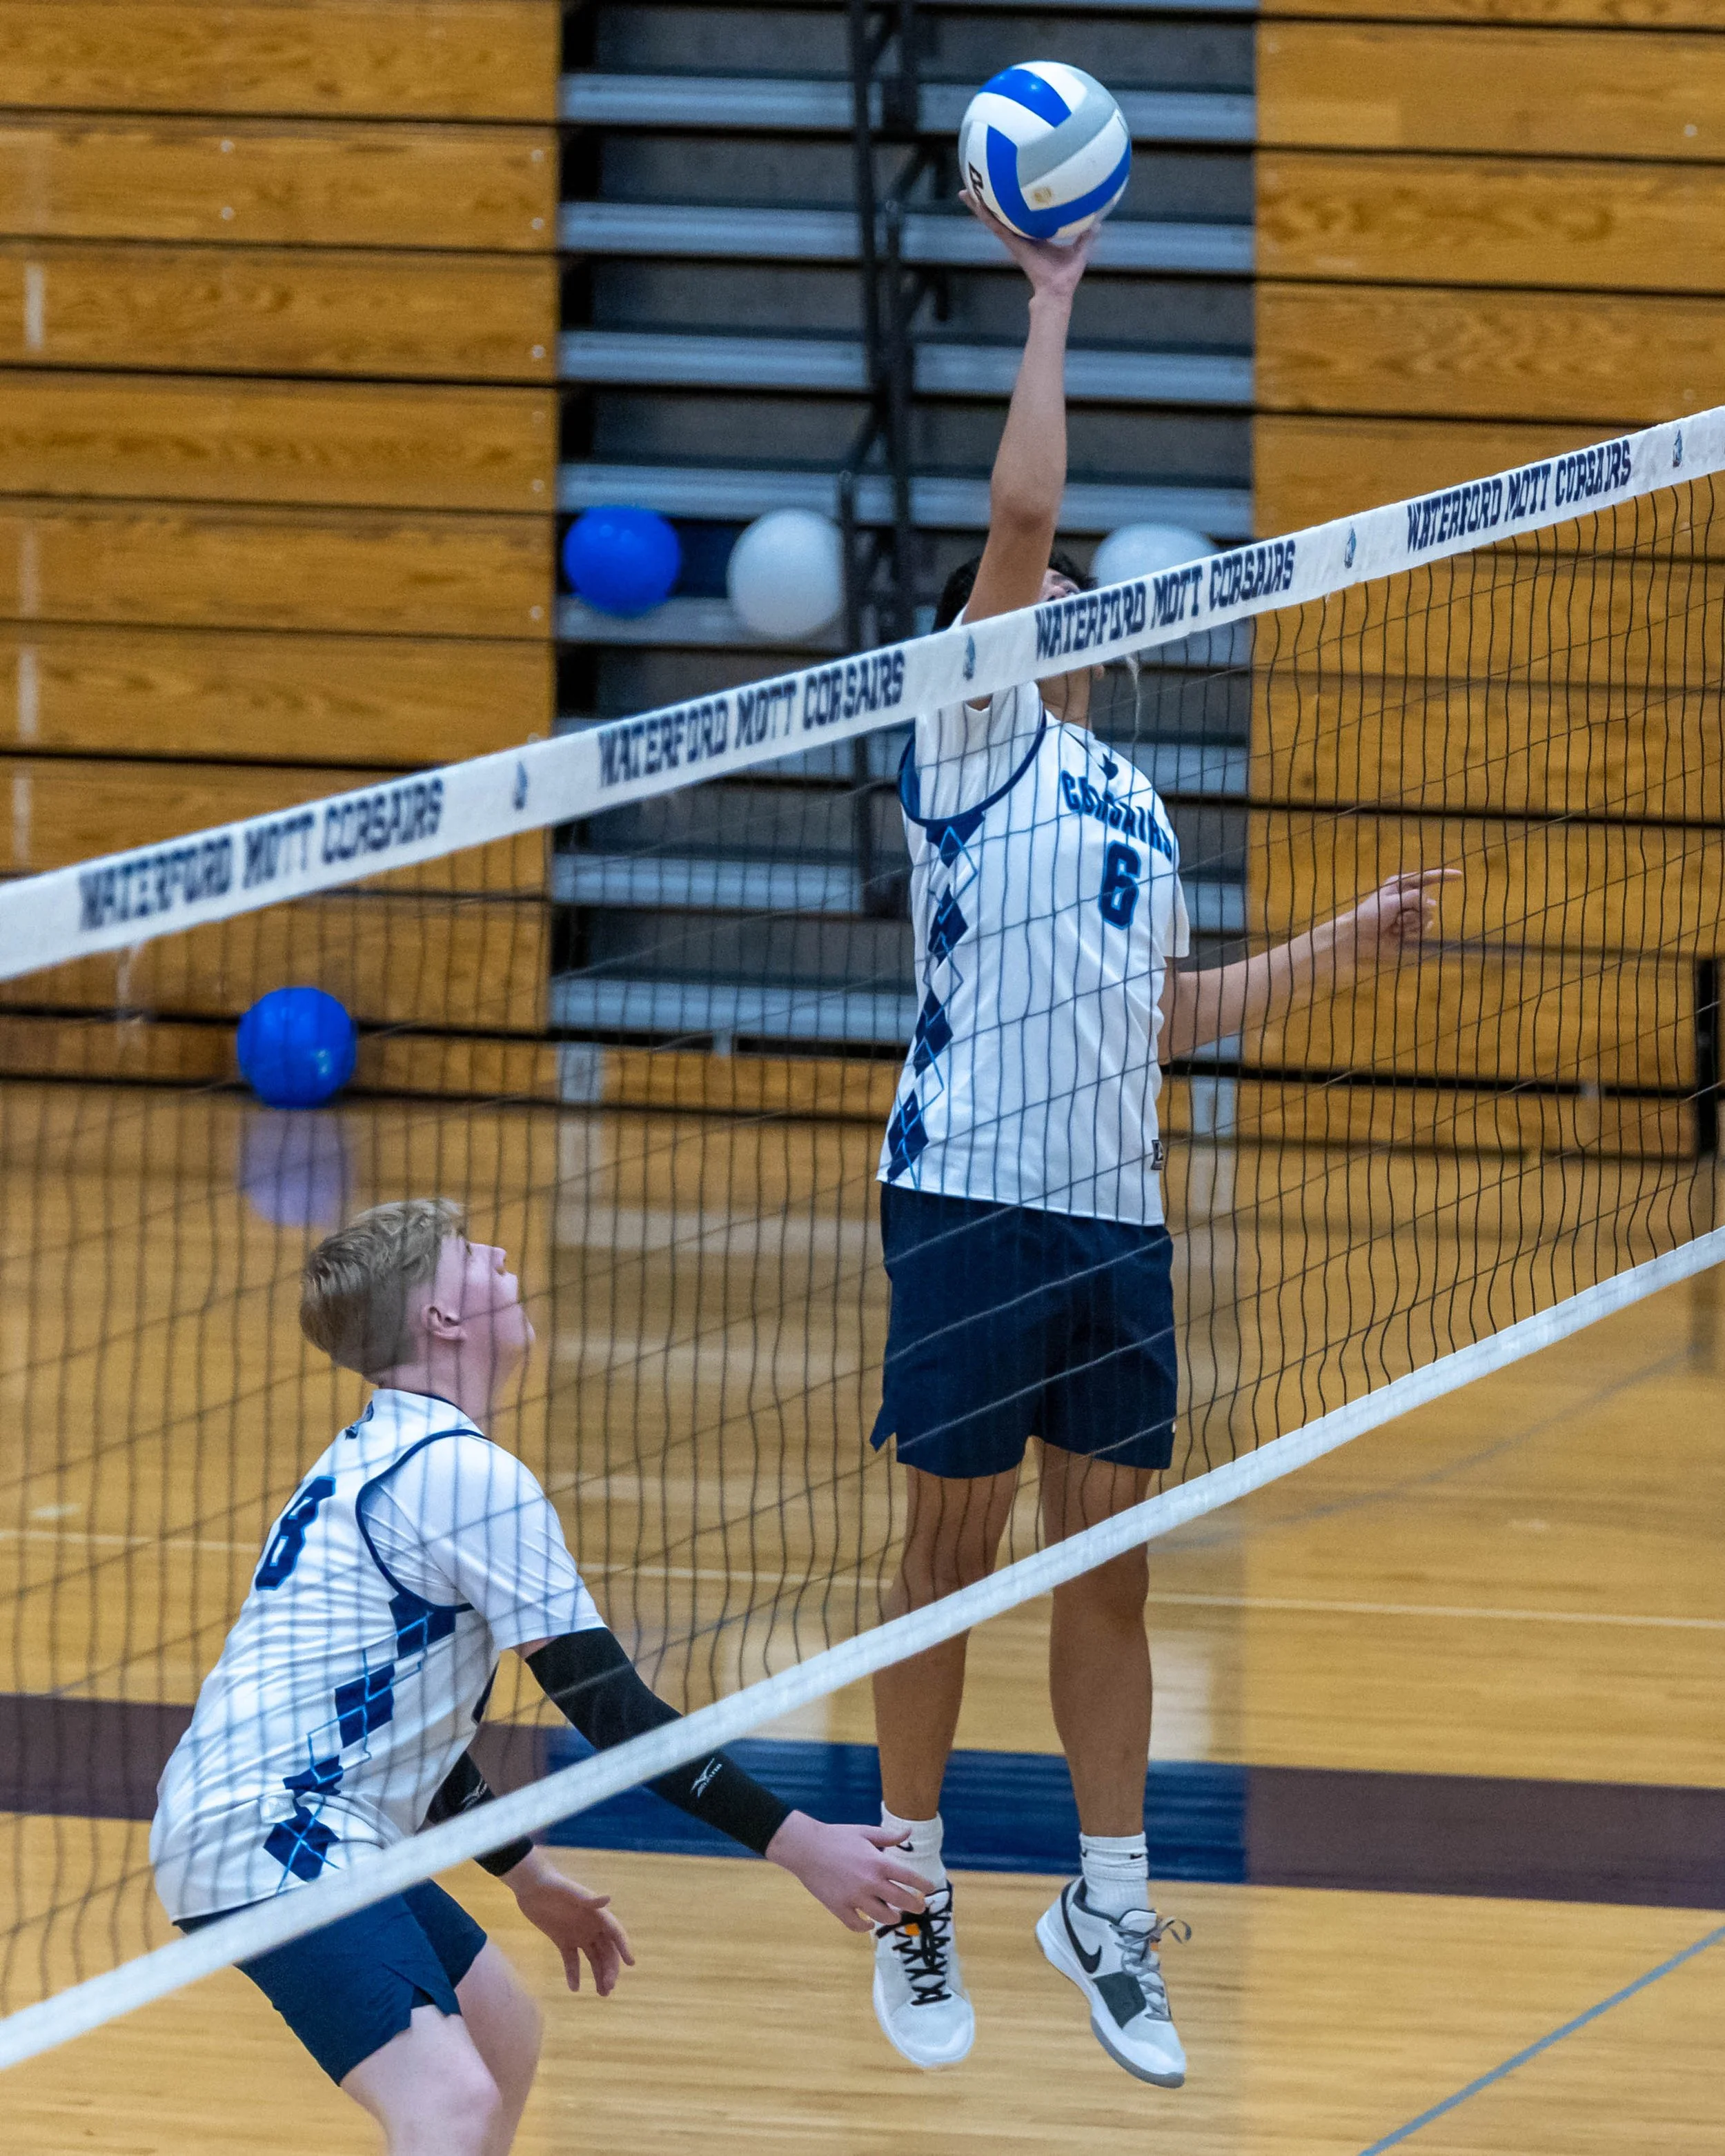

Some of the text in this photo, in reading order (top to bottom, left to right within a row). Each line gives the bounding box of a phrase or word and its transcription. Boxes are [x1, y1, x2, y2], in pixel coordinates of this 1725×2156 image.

[1407, 439, 1631, 553] WATERFORD MOTT CORSAIRS
[1036, 539, 1296, 660] WATERFORD MOTT CORSAIRS
[598, 649, 905, 788] WATERFORD MOTT CORSAIRS
[78, 778, 443, 931] WATERFORD MOTT CORSAIRS
[1098, 840, 1141, 930] 6
[255, 1476, 337, 1591] 8
